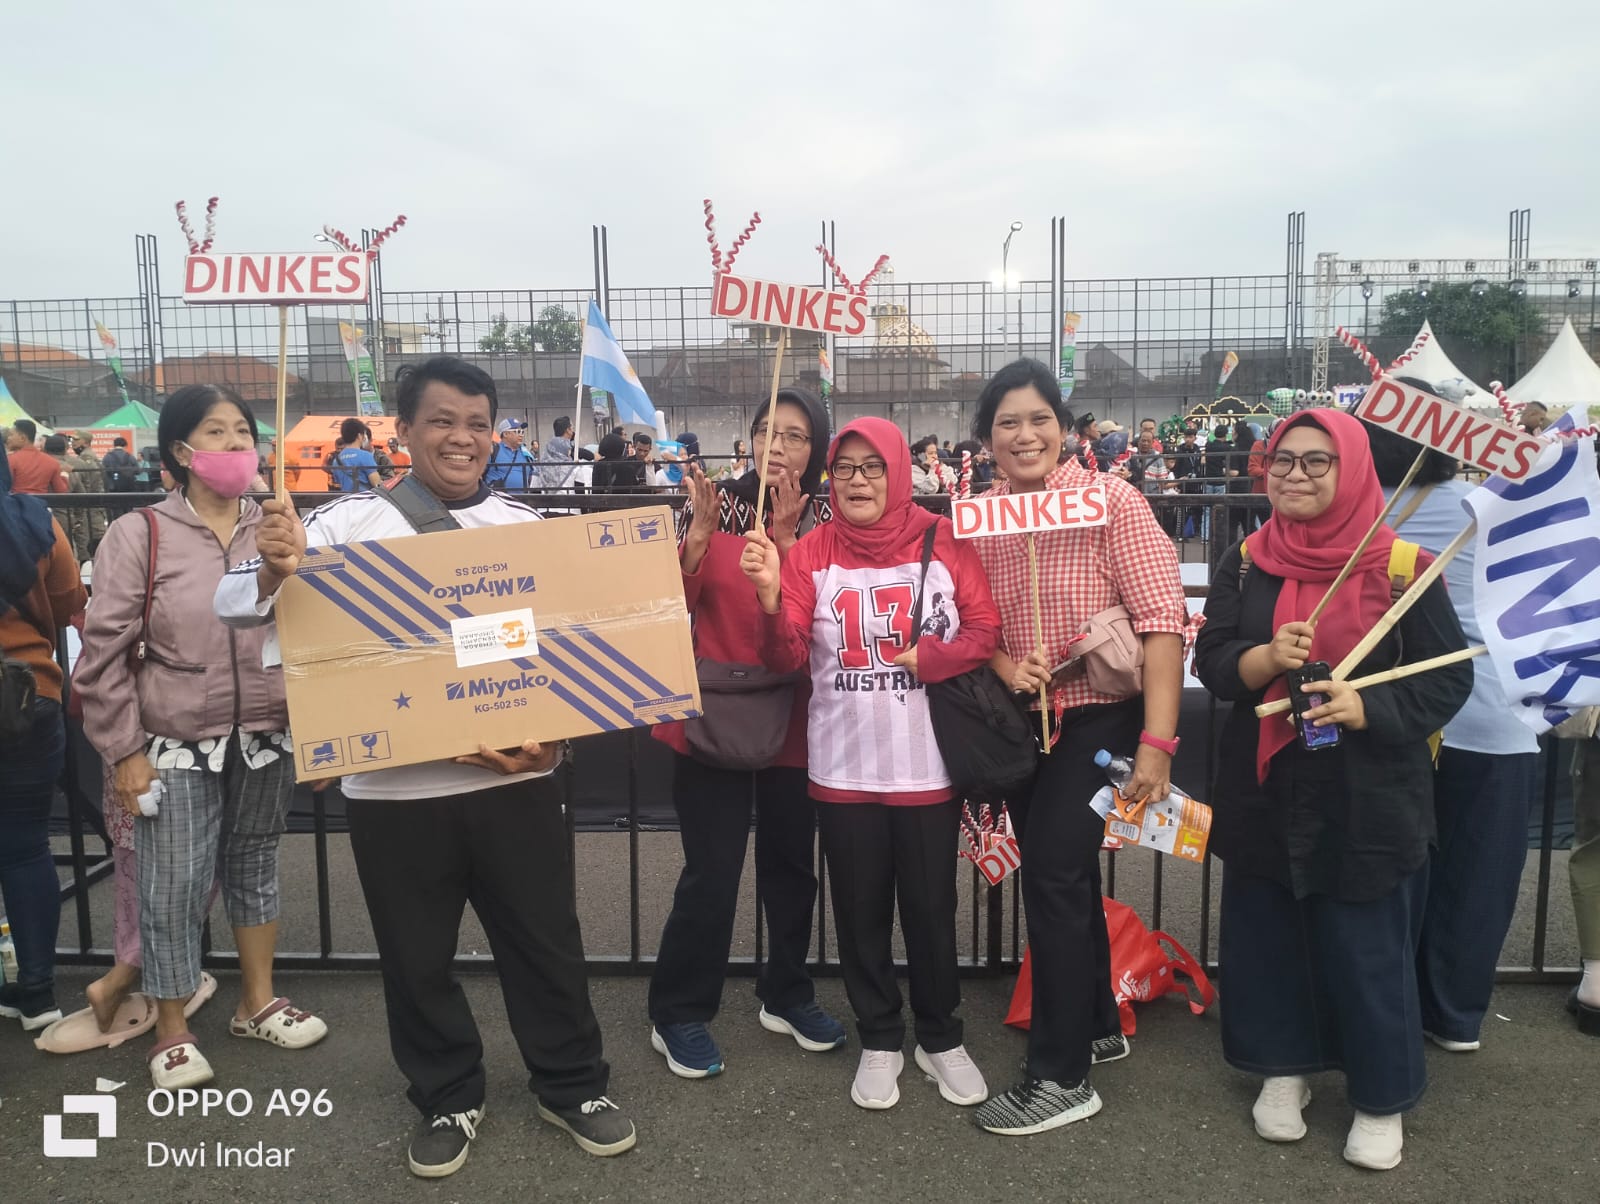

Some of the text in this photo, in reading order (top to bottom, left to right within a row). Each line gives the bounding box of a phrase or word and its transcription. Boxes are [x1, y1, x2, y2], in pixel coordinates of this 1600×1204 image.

[184, 254, 360, 294] DINKES
[717, 275, 868, 336] DINKES
[1363, 379, 1540, 481] DINKES
[955, 487, 1105, 535] DINKES
[455, 562, 508, 577] KG-502 SS
[1481, 411, 1600, 727] DINK
[433, 577, 514, 602] Miyako
[831, 582, 917, 670] 13
[463, 642, 497, 650] LEMBAGA
[468, 672, 549, 698] Miyako
[834, 671, 925, 692] AUSTRI
[474, 697, 528, 714] KG-502 SS
